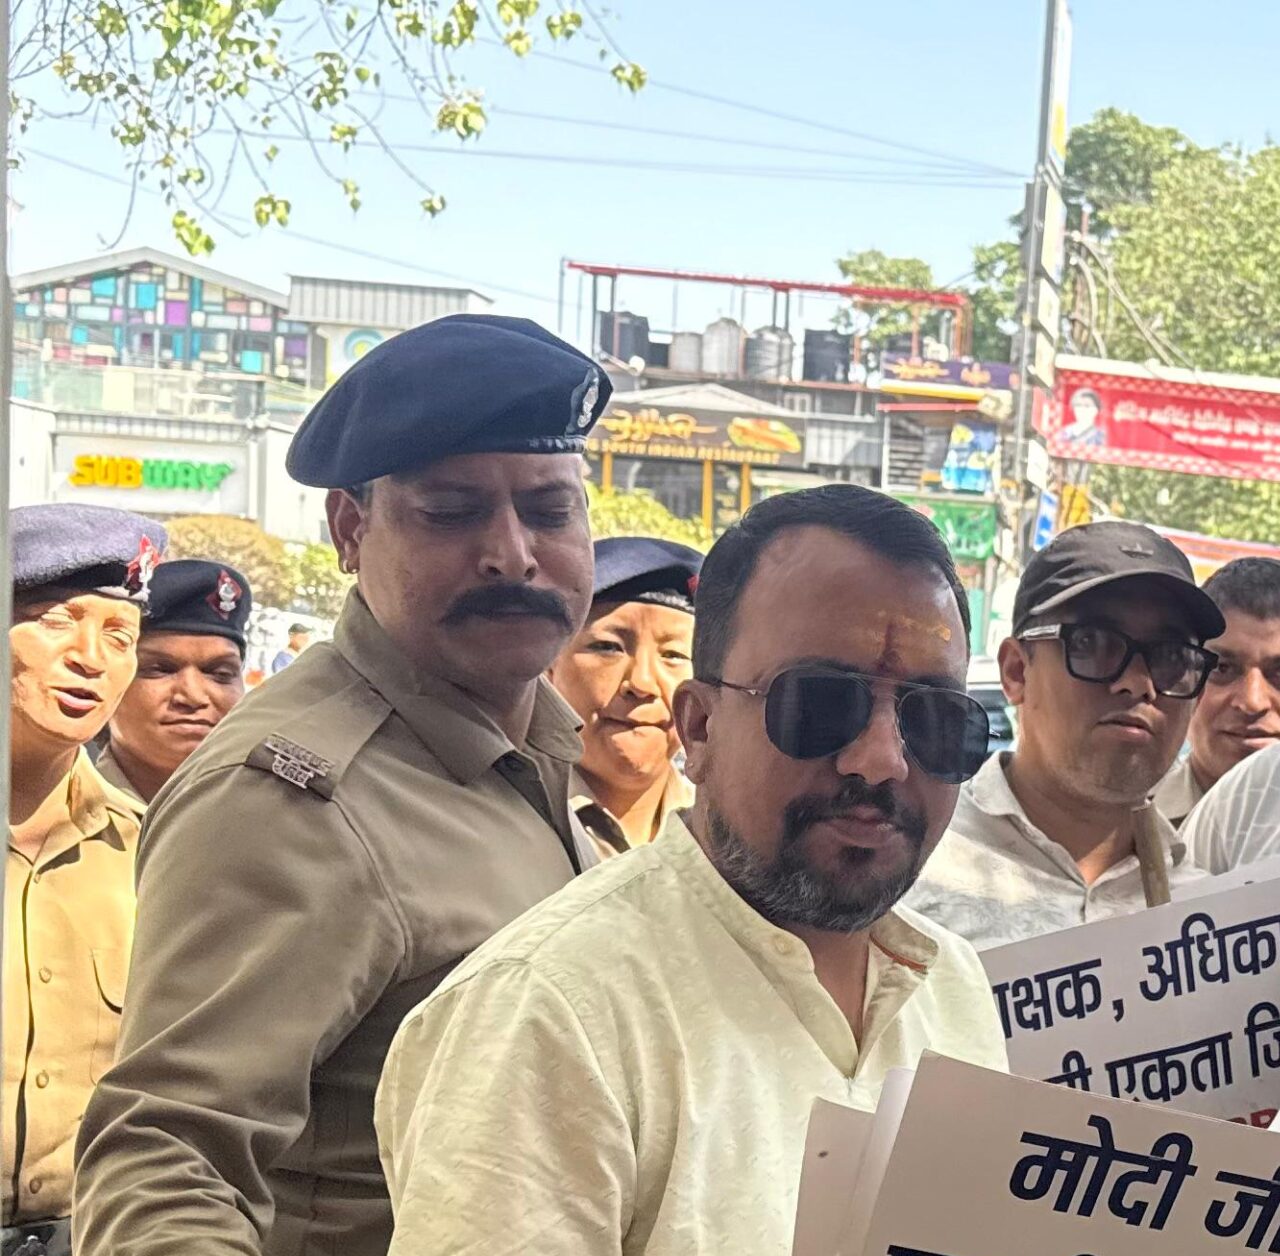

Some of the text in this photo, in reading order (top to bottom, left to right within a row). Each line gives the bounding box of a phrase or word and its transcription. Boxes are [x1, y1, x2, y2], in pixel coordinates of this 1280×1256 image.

[69, 455, 236, 492] SUBWAY
[1105, 1032, 1233, 1102] एकता
[1008, 1114, 1198, 1231] मोदी
